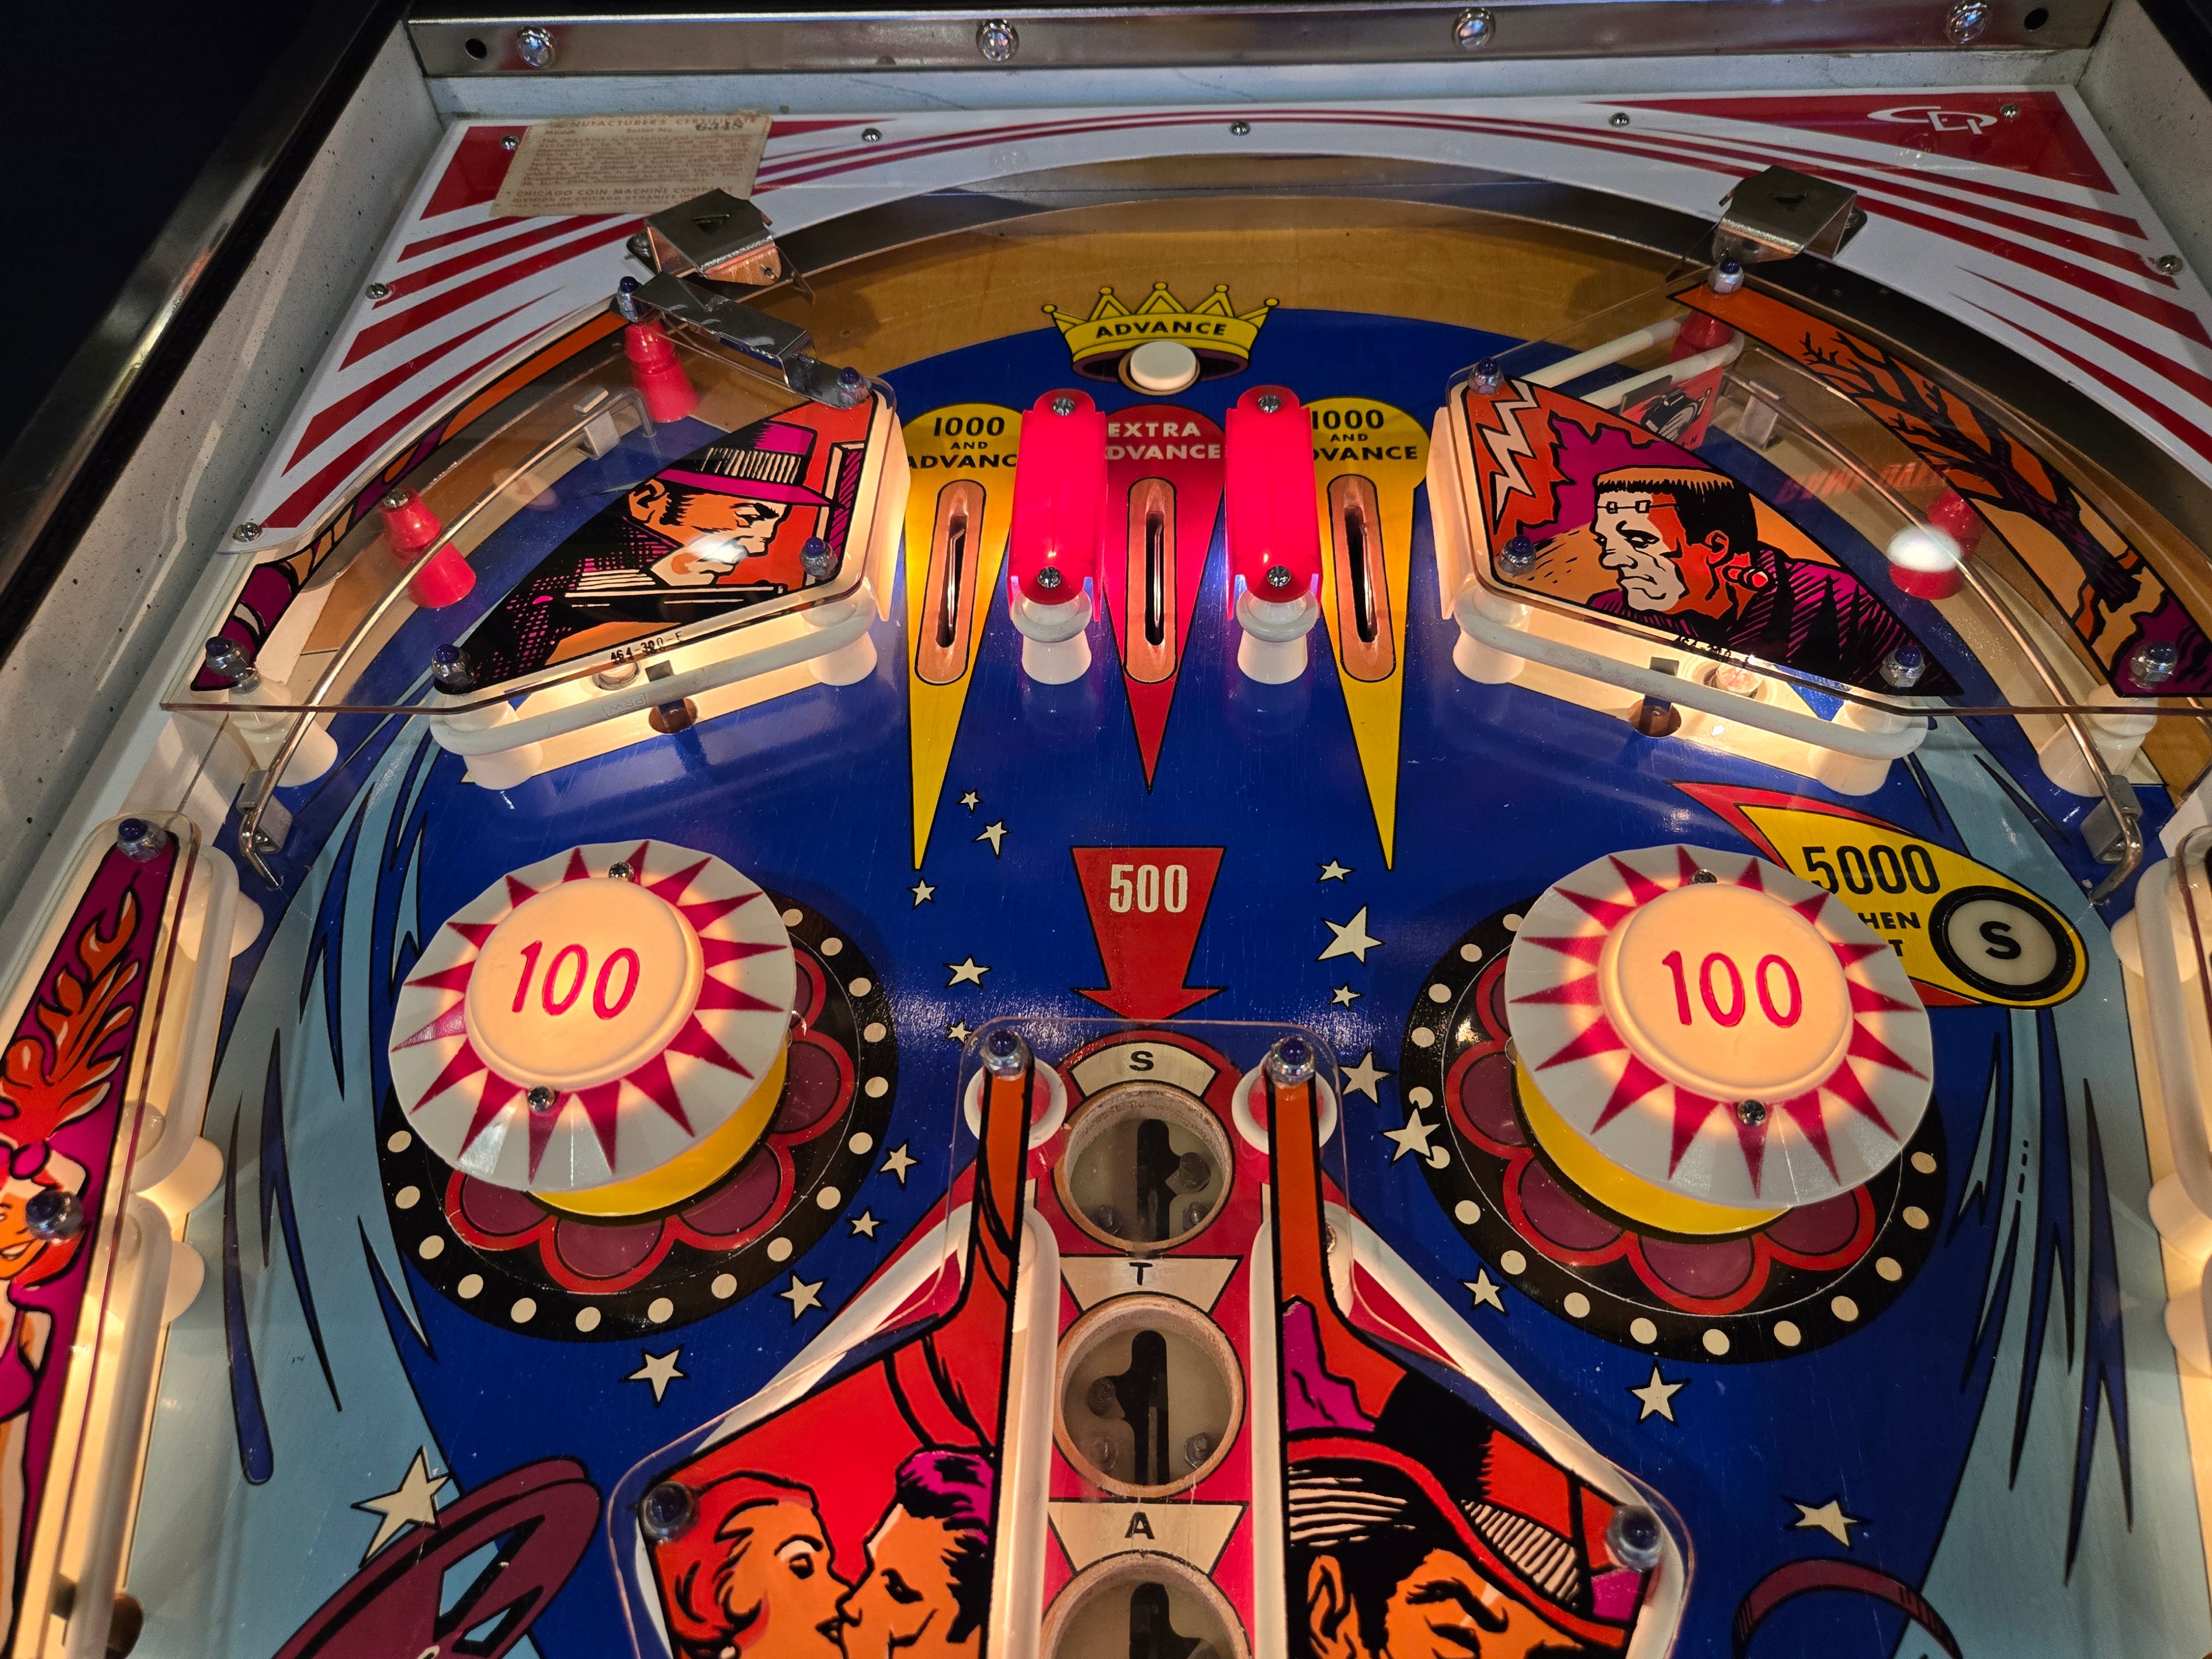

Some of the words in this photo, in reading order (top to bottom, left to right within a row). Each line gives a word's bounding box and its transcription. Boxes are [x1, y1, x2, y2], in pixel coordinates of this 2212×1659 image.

[1096, 321, 1227, 338] ADVANCE
[934, 416, 1005, 437] 1000
[1108, 423, 1201, 437] EXTRA
[1312, 410, 1384, 430] 1000
[950, 441, 988, 450] AND
[1330, 434, 1368, 442] AND
[908, 454, 1018, 469] ADVANC
[1105, 445, 1221, 460] DVANCE
[1802, 844, 1941, 895] 5000
[1109, 864, 1188, 913] 500
[1857, 912, 1921, 929] HEN
[1979, 921, 2022, 960] S
[512, 940, 640, 1020] 100
[1661, 950, 1802, 1028] 100
[1129, 1050, 1154, 1071] S
[1130, 1262, 1153, 1285] T
[1124, 1512, 1156, 1540] A
